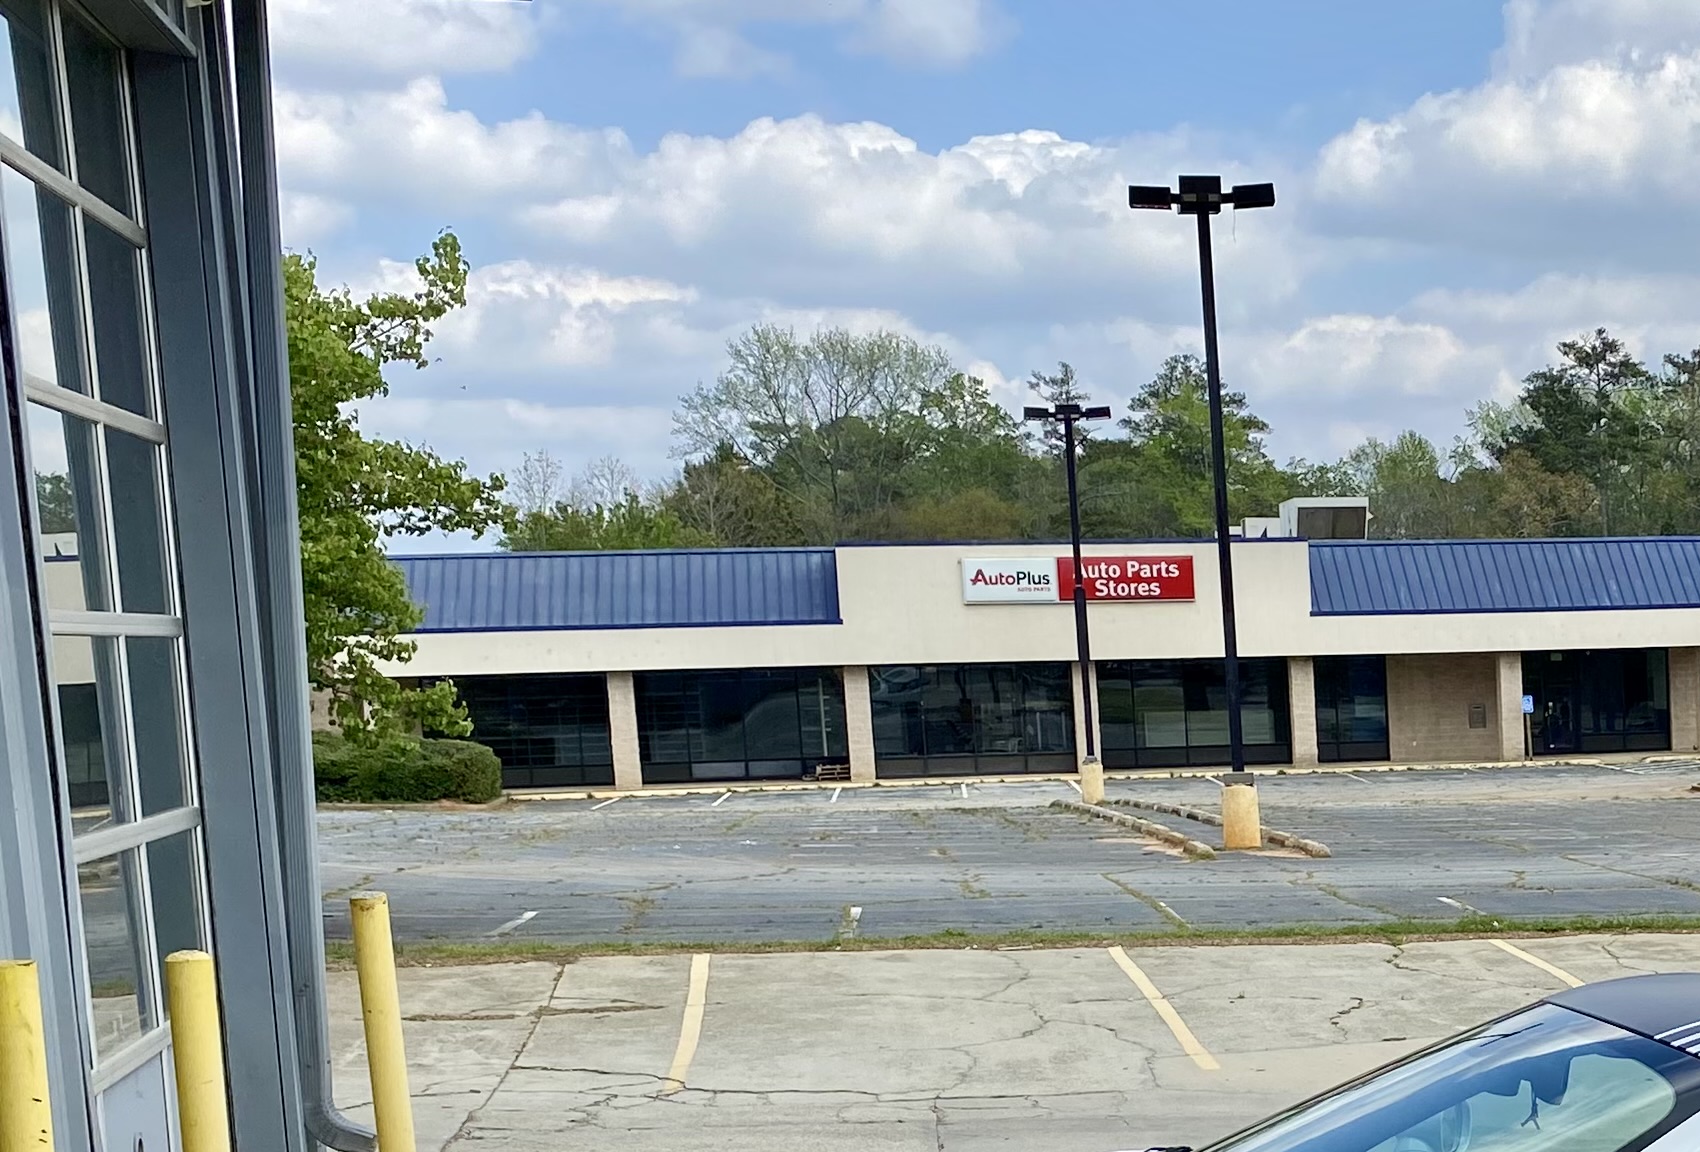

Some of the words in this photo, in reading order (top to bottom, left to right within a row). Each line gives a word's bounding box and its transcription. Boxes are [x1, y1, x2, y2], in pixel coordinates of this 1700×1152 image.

[970, 569, 1050, 586] AutoPlus
[1126, 560, 1180, 578] Parts
[1095, 578, 1161, 597] Stores
